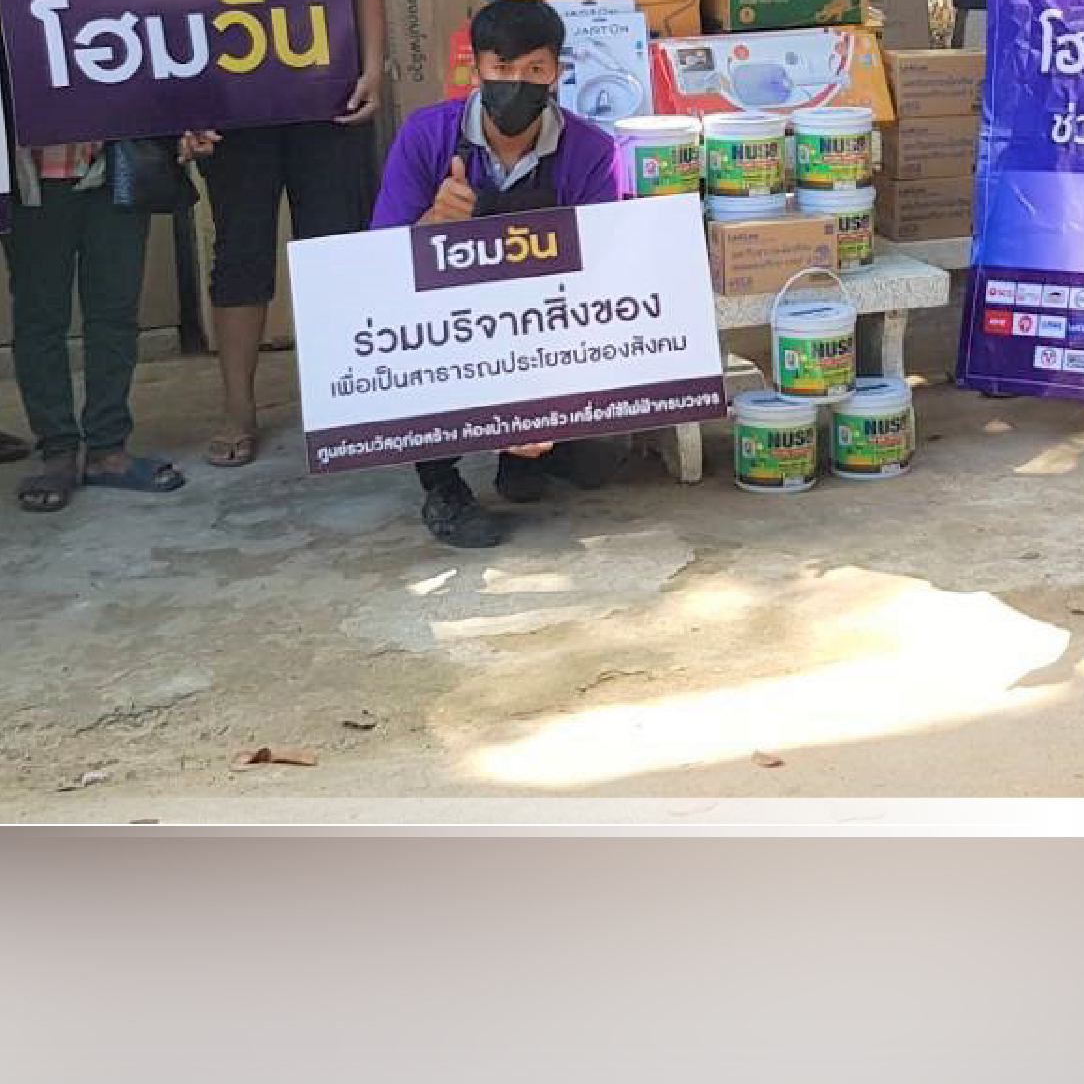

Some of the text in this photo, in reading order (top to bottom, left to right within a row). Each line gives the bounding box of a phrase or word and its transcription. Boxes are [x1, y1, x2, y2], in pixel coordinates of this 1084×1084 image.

[430, 225, 559, 272] โฮมวัน
[353, 282, 661, 357] ร่วมบริจาคสิ่งของ
